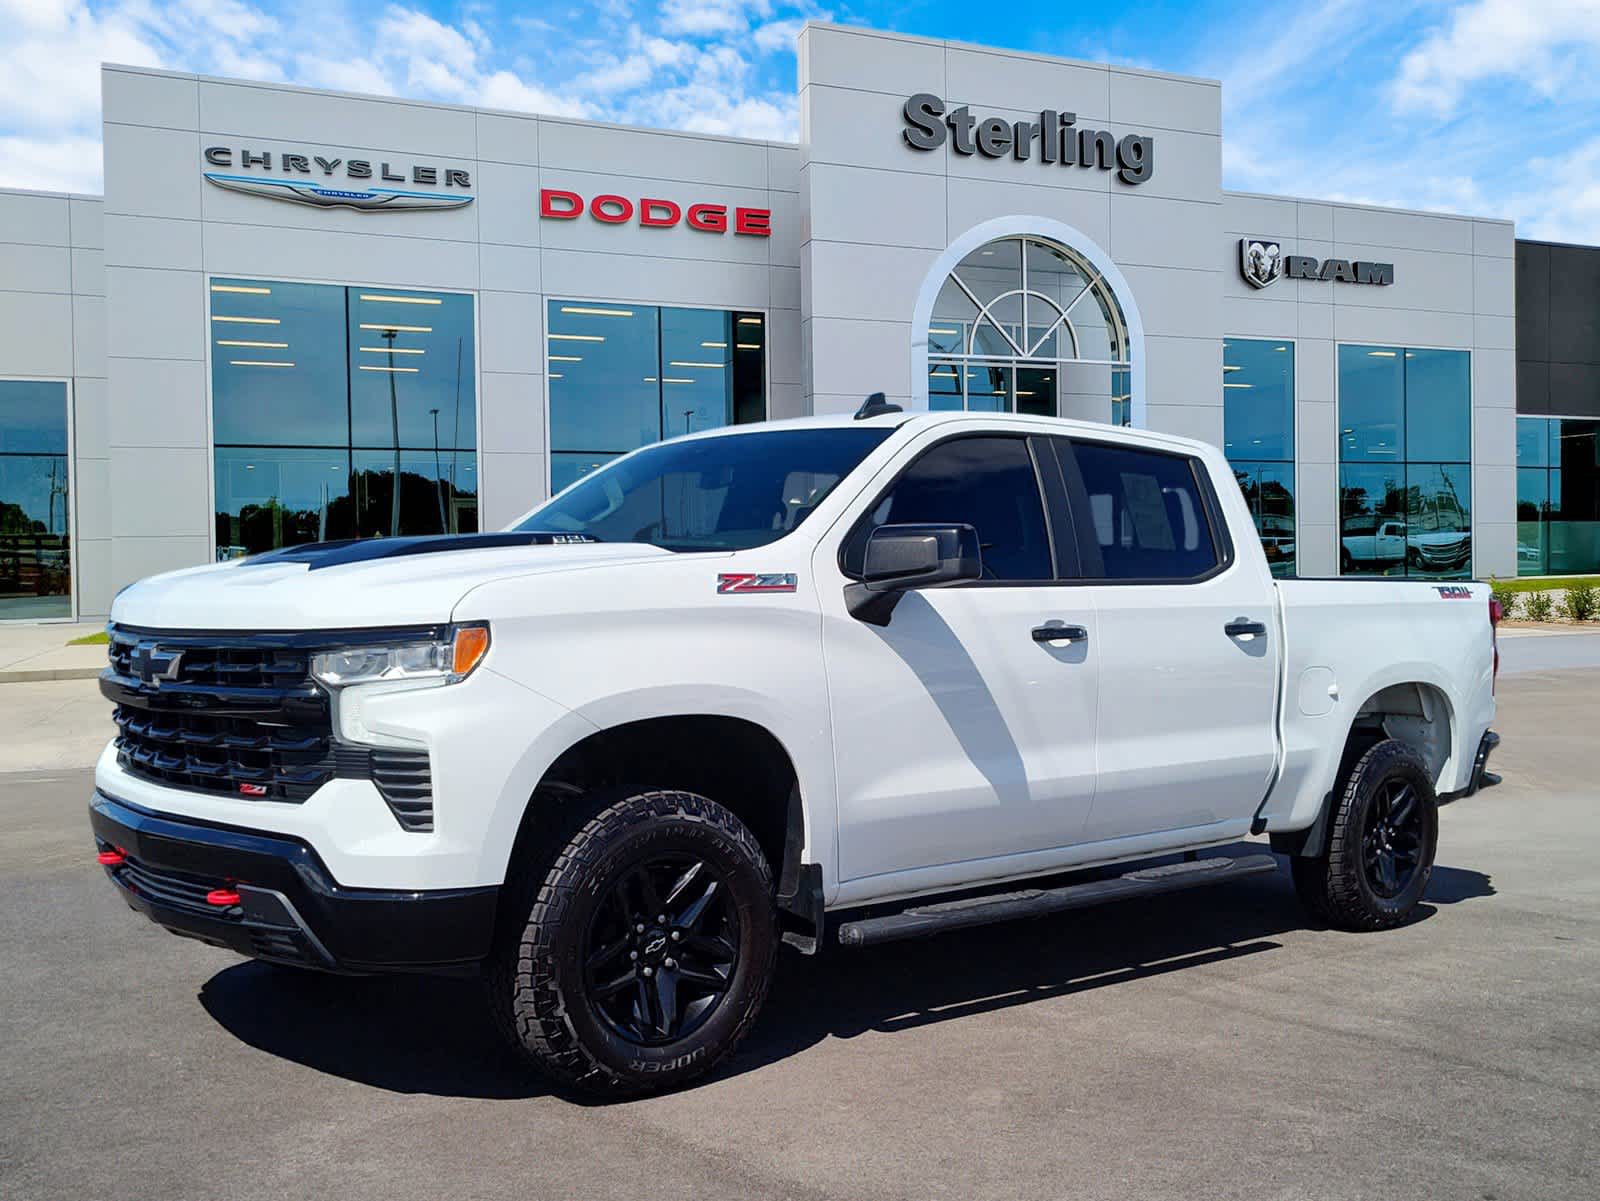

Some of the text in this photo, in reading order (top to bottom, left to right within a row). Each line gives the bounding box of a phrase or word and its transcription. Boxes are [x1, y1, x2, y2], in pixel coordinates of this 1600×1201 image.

[903, 93, 1154, 185] Sterling
[204, 146, 472, 188] CHRYSLER
[540, 188, 772, 237] DODGE
[1284, 255, 1395, 286] RAM
[717, 573, 798, 594] Z71
